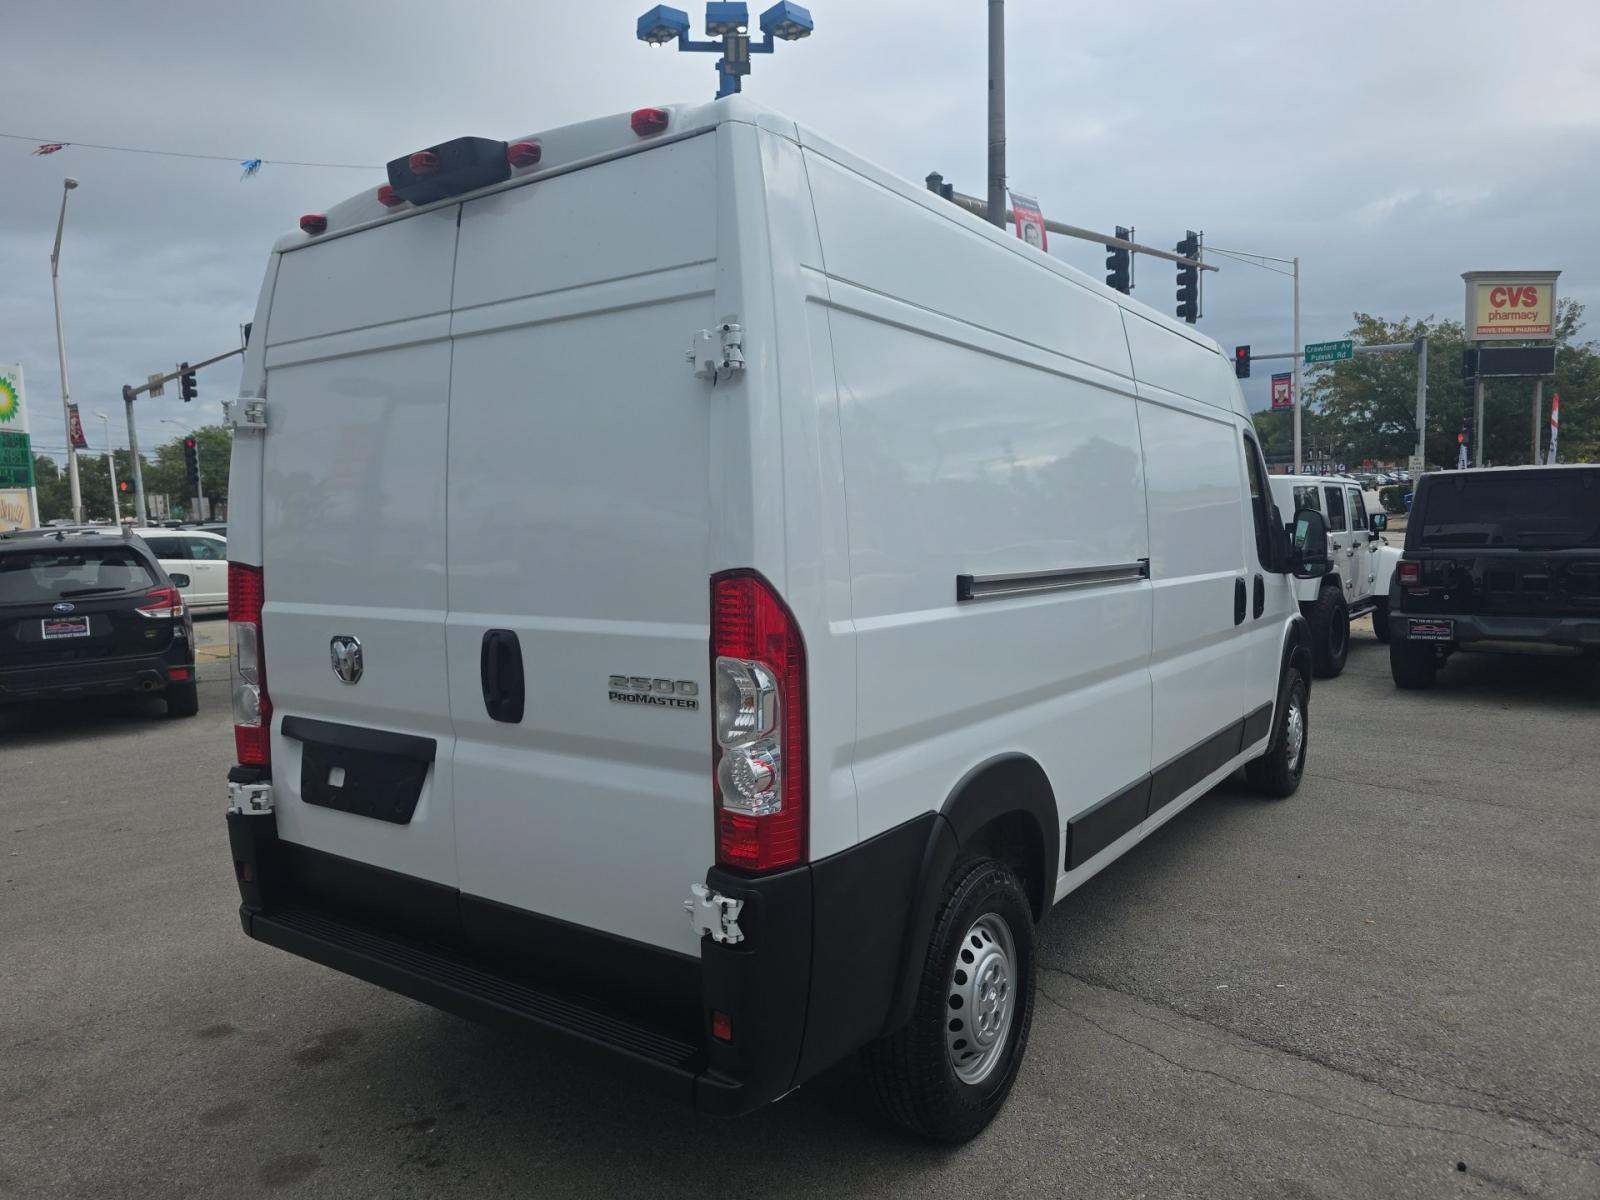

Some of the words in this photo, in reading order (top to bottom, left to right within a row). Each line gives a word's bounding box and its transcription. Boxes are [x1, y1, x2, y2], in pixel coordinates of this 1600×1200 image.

[1490, 286, 1538, 308] CVS
[1488, 310, 1538, 323] pharmacy
[608, 675, 698, 695] 2500
